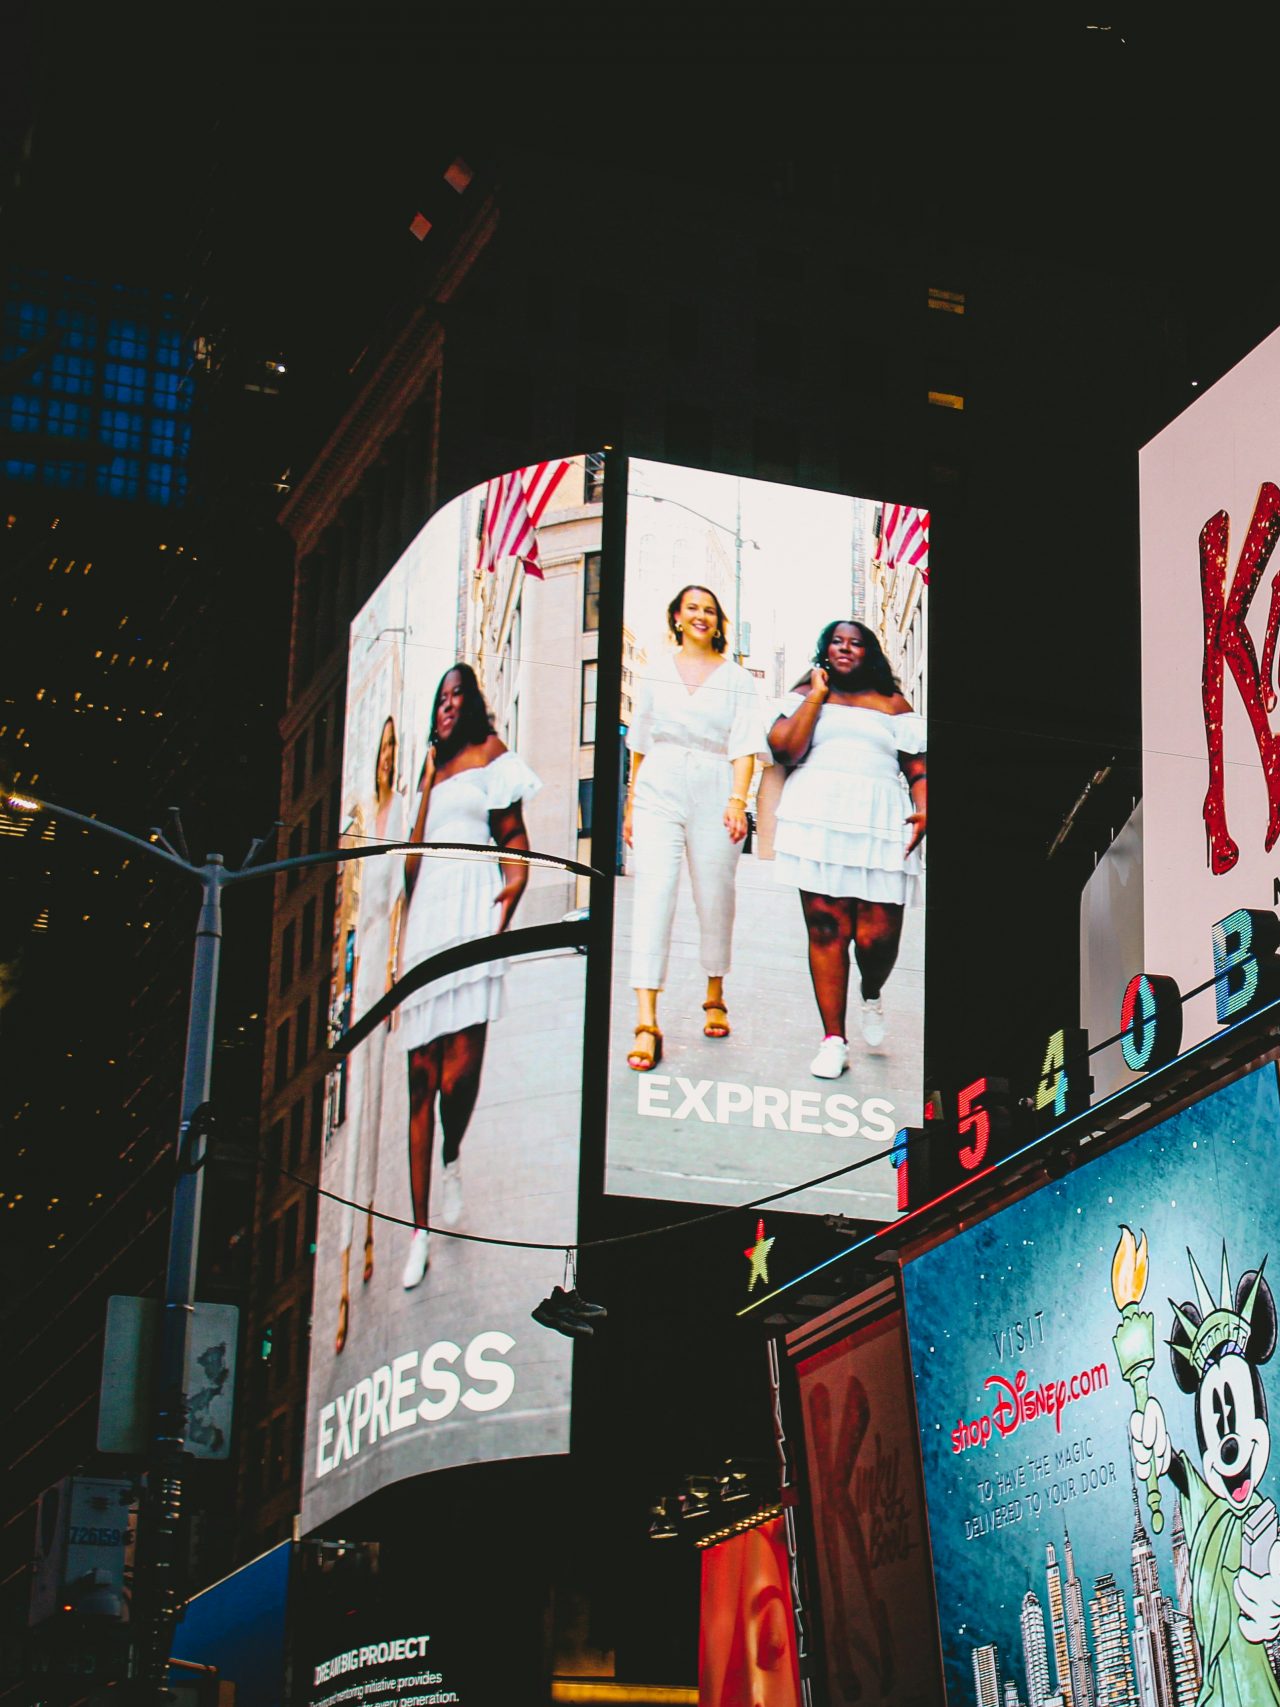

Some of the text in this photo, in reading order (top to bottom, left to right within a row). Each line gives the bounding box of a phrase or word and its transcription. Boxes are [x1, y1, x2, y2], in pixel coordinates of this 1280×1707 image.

[637, 1073, 897, 1142] EXPRESS
[992, 1310, 1045, 1363] VISIT
[316, 1331, 517, 1479] EXPRESS
[977, 1437, 1095, 1505] TO HAVE THE MAGIC
[964, 1462, 1118, 1541] DELIVERED TO YOUR DOOR
[340, 1648, 359, 1674] BIG
[358, 1635, 430, 1668] PROJECT
[364, 1677, 397, 1695] initiative
[397, 1670, 443, 1692] provides
[399, 1690, 460, 1707] generation.
